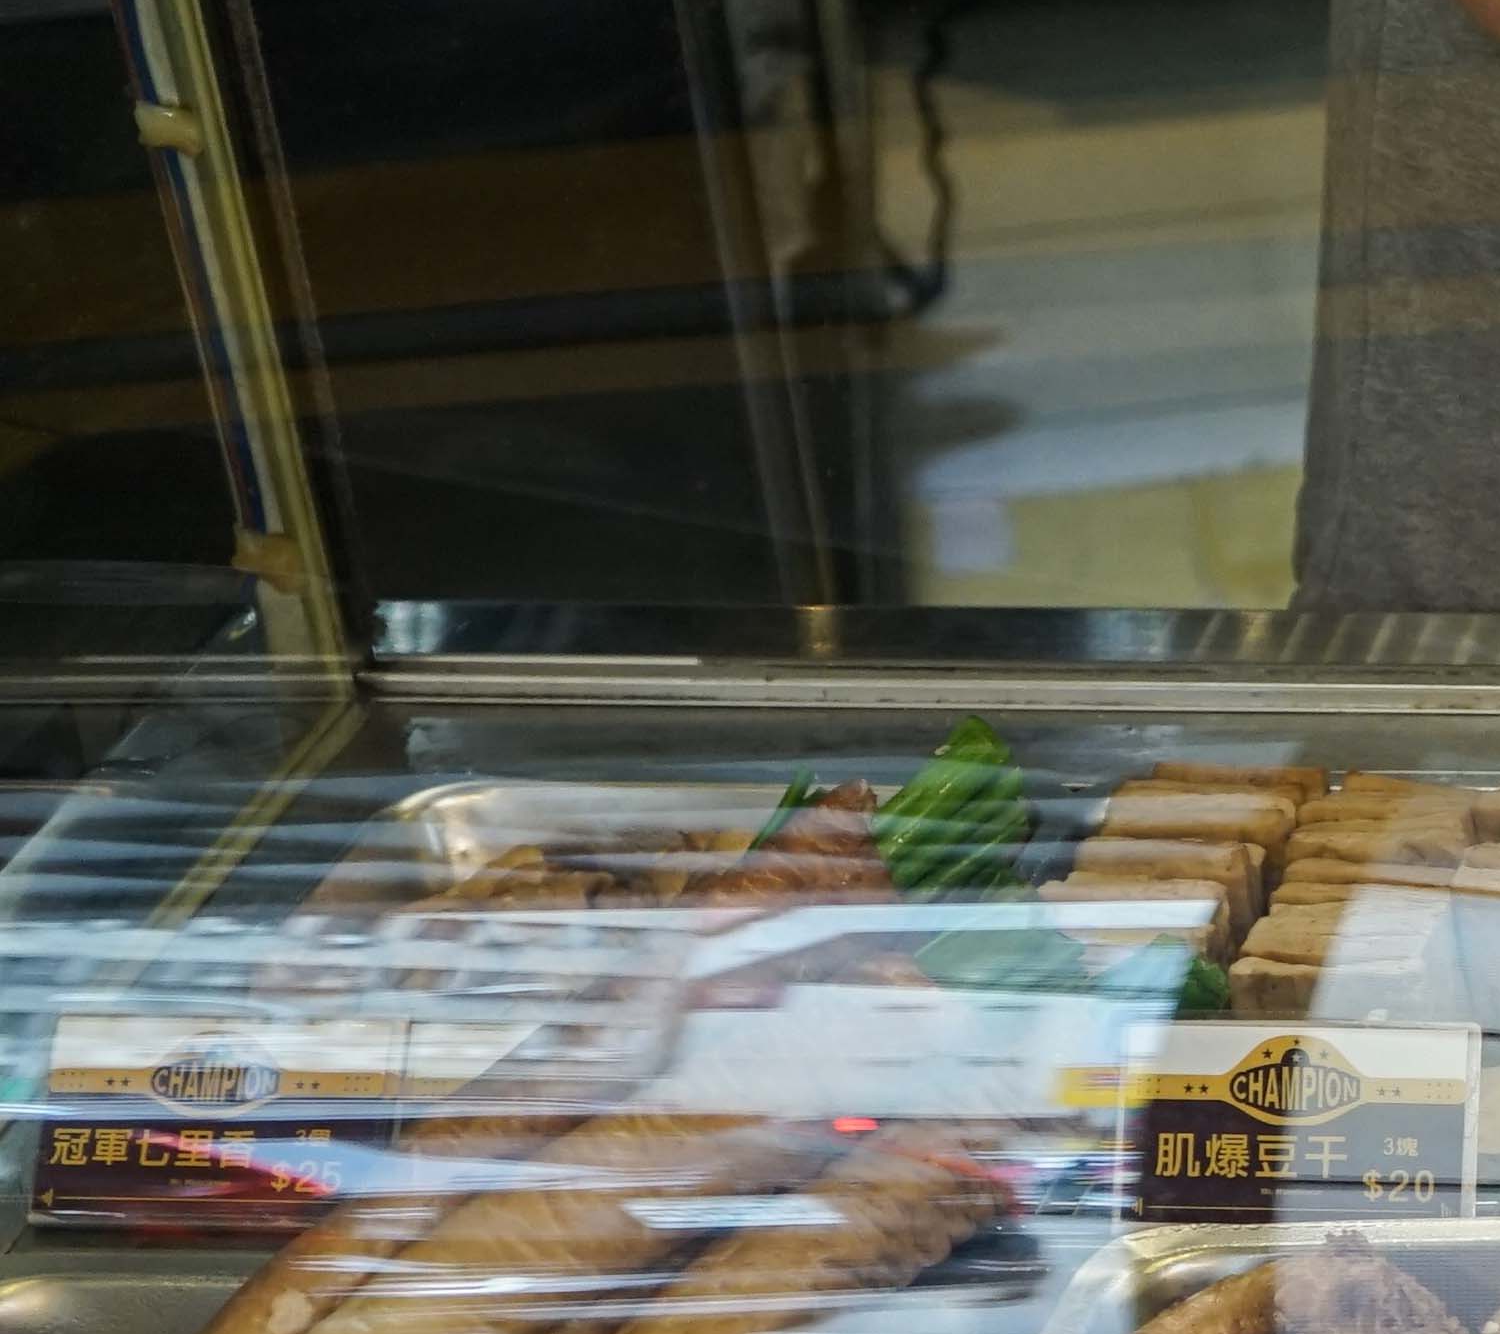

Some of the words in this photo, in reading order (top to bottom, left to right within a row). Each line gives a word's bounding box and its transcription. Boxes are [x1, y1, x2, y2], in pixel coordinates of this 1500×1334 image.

[1231, 1066, 1360, 1111] CHAMPION
[49, 1127, 256, 1169] 冠軍七里香
[1154, 1131, 1349, 1180] 肌爆豆干
[1361, 1168, 1436, 1205] $20
